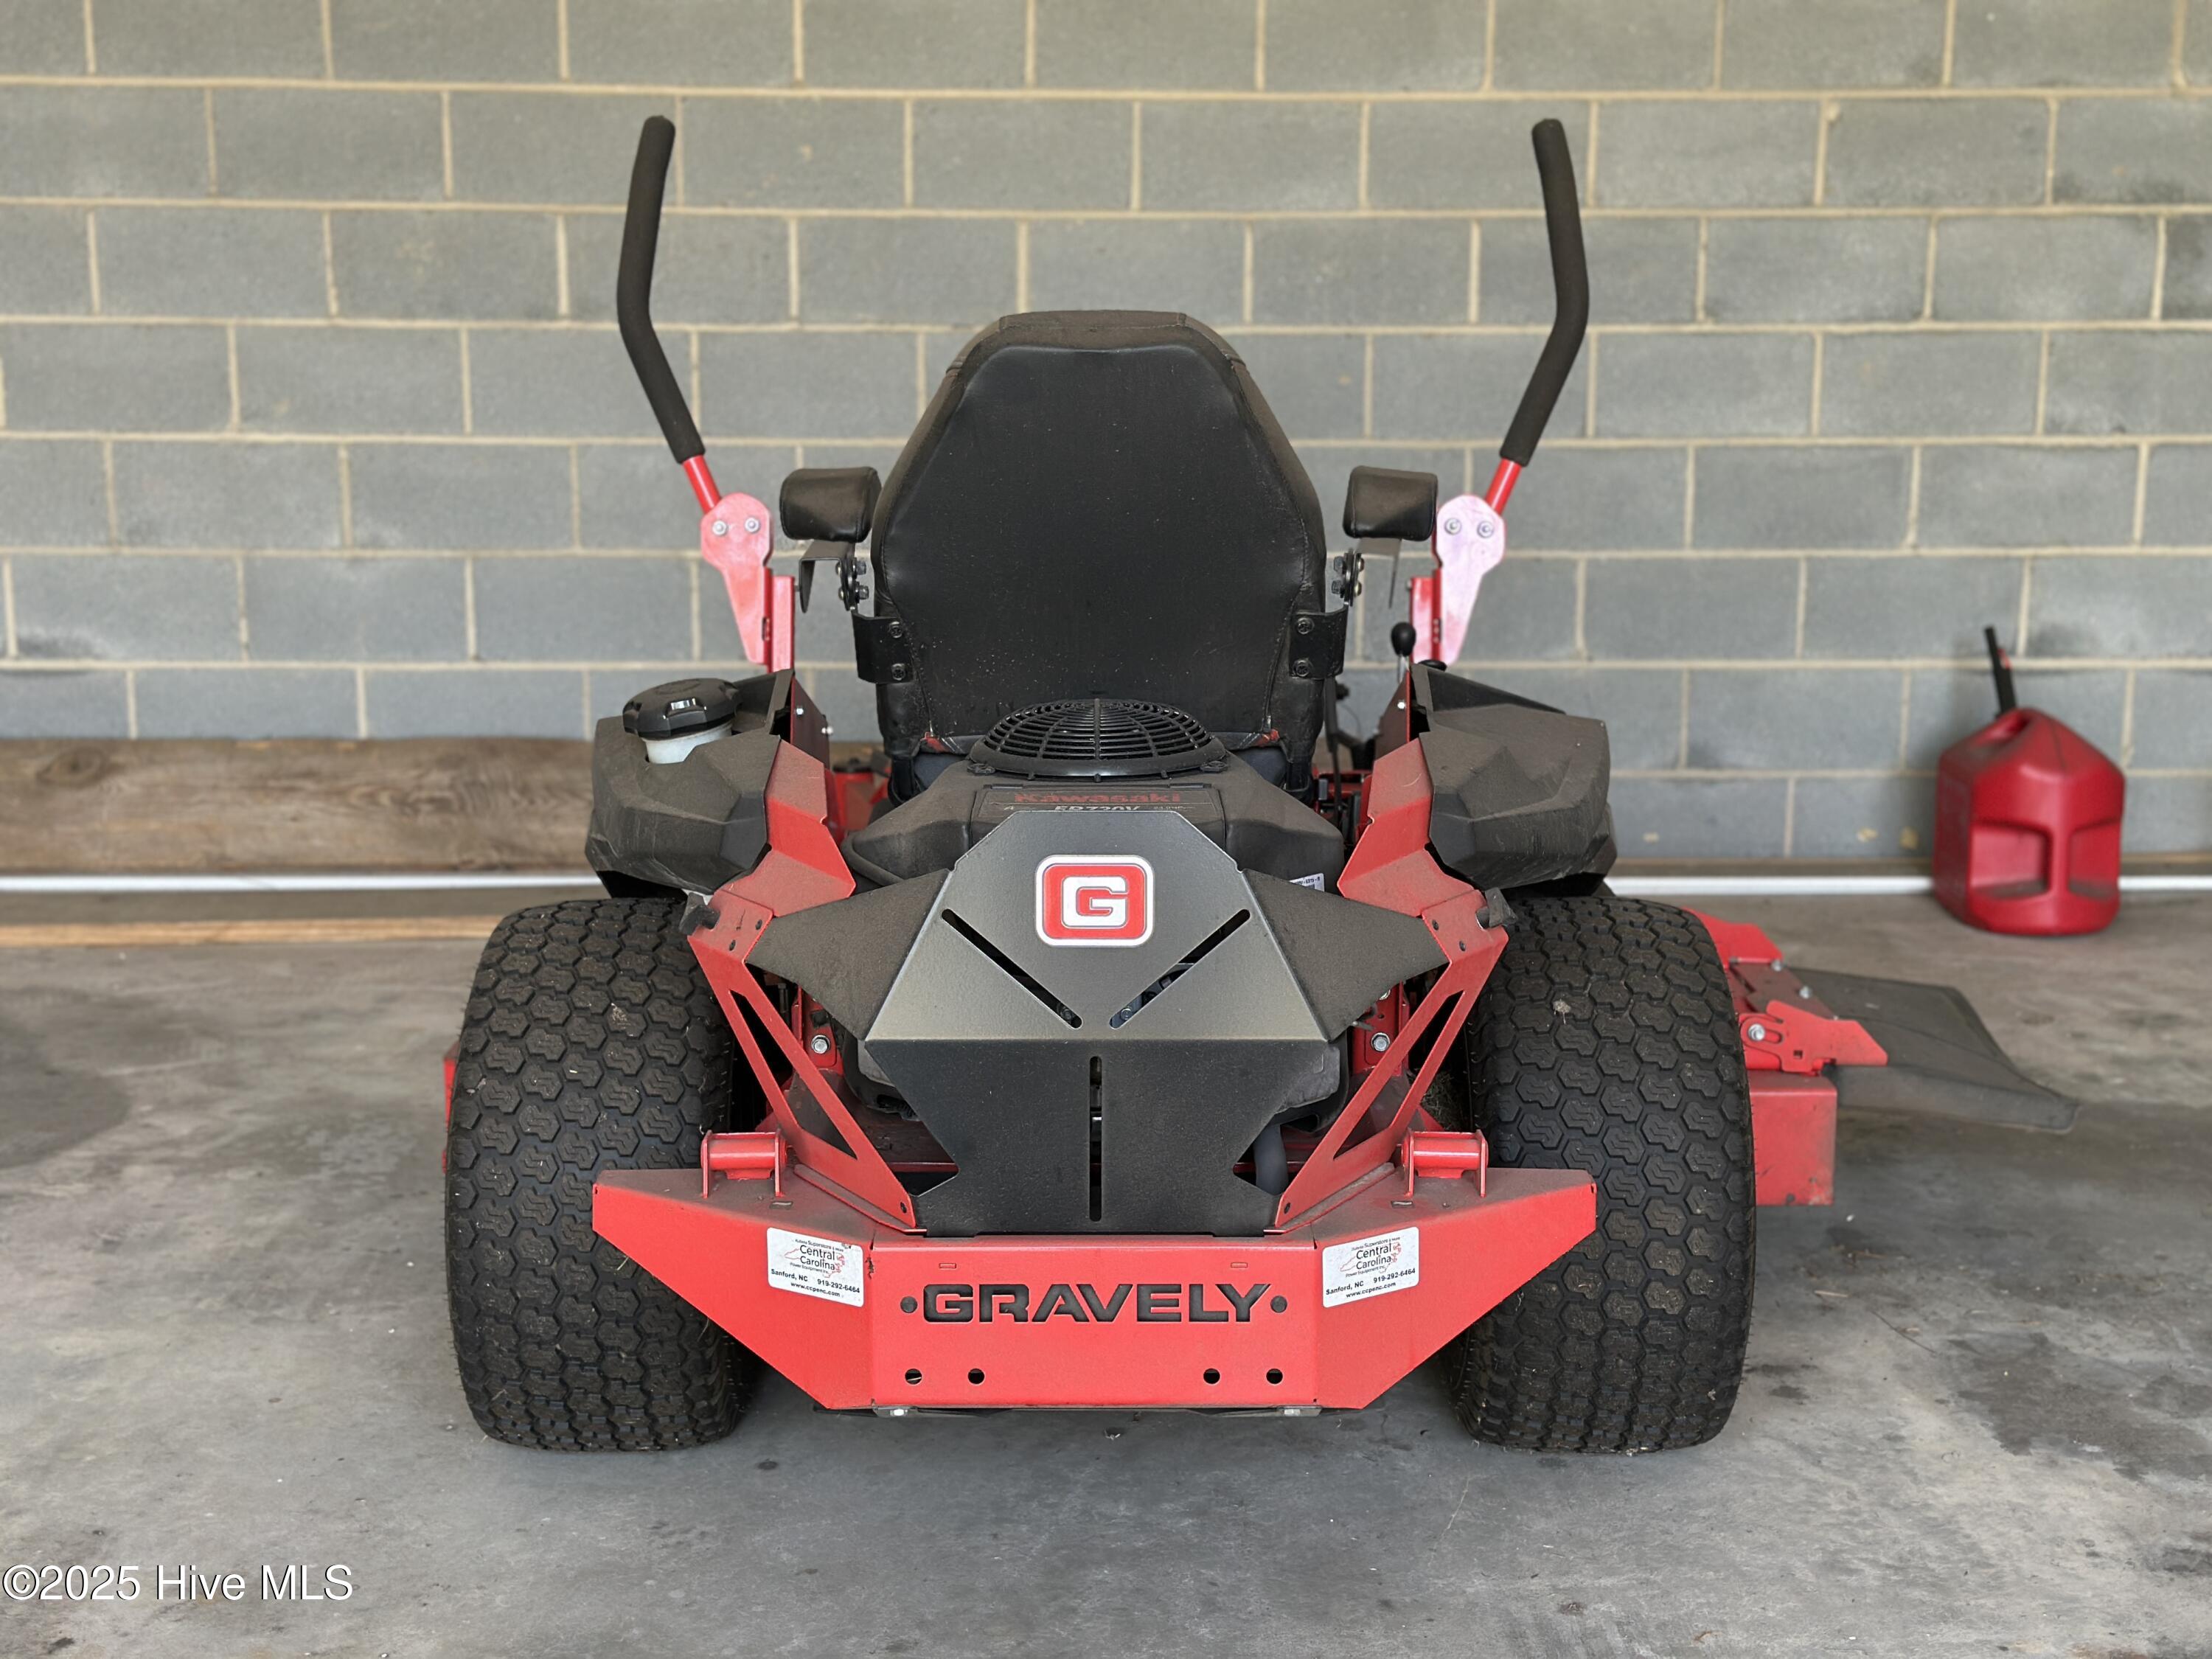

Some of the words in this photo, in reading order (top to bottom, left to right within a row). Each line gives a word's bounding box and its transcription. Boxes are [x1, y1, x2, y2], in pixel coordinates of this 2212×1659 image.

[1015, 793, 1180, 803] Kawasaki
[800, 1245, 835, 1261] Central
[1356, 1242, 1391, 1259] Central
[800, 1256, 835, 1270] Carolina
[1356, 1255, 1391, 1270] Carolina
[771, 1268, 797, 1281] Sanford,
[817, 1279, 860, 1293] 919-292-6464
[1326, 1284, 1353, 1295] Sanford,
[1373, 1267, 1416, 1284] 919-292-6464
[923, 1284, 1271, 1323] GRAVELY
